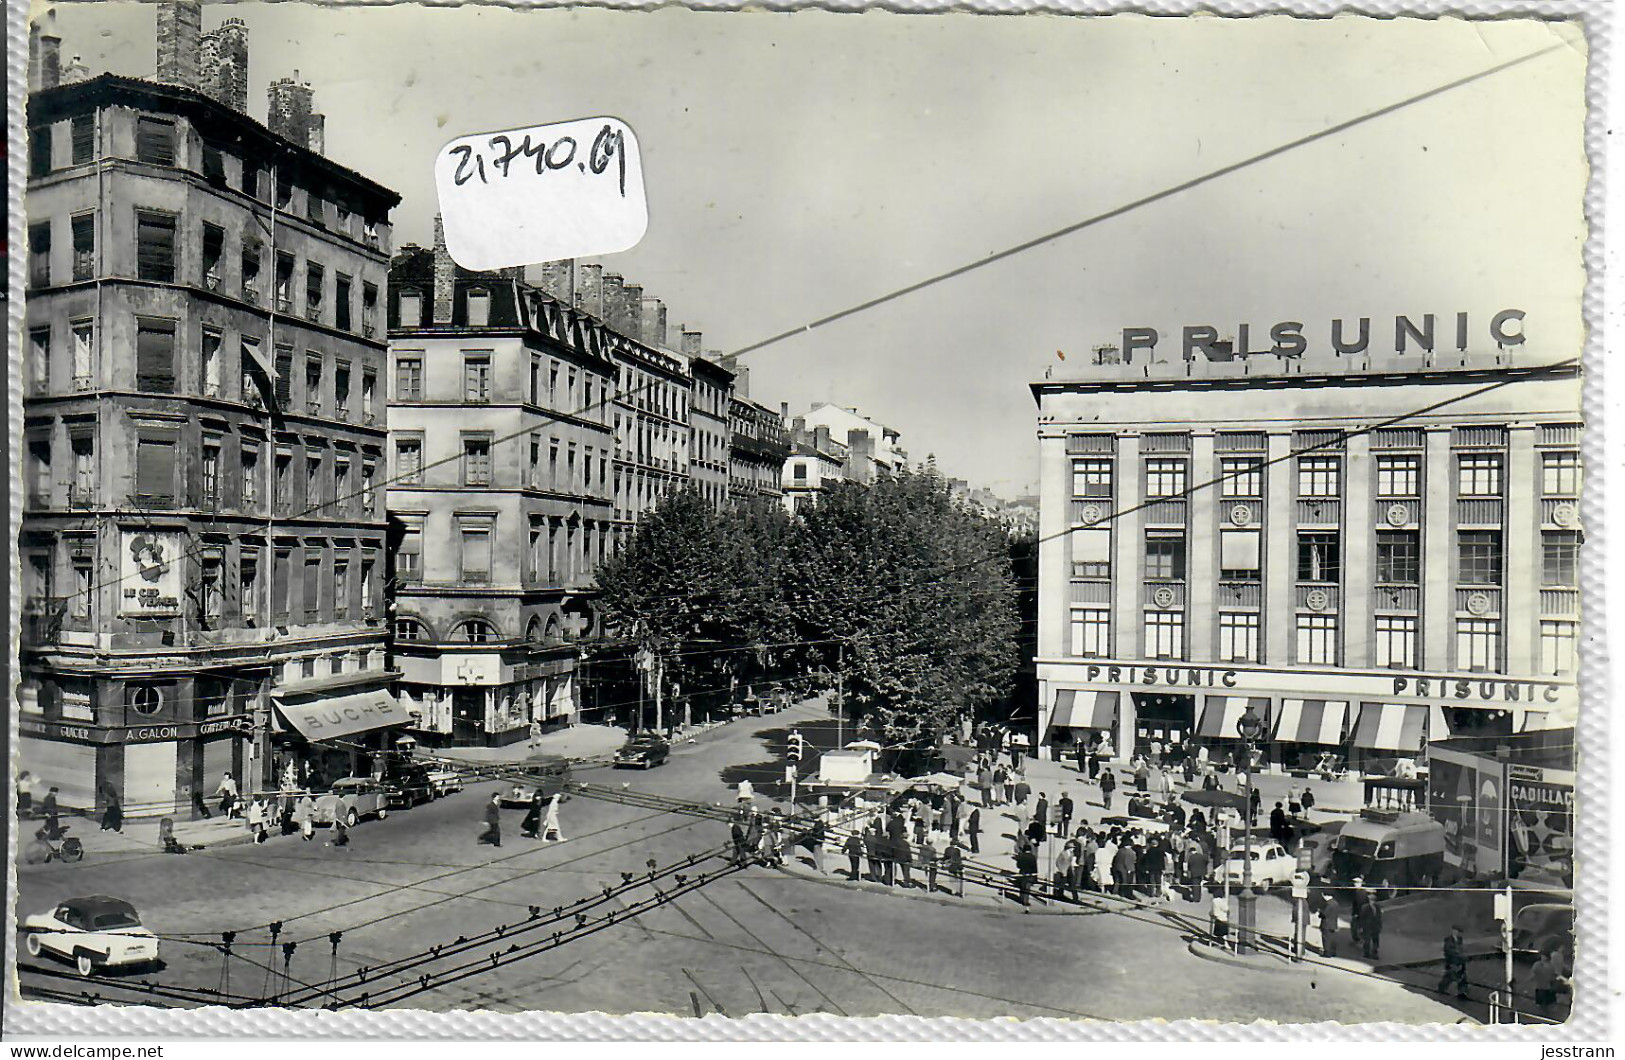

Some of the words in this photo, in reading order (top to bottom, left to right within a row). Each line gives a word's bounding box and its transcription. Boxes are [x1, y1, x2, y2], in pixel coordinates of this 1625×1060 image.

[1123, 309, 1527, 362] PRISUNIC
[1087, 666, 1237, 687] PRISUNIC
[1393, 676, 1559, 702] PRISUNIC
[1511, 785, 1573, 806] CADILLAC
